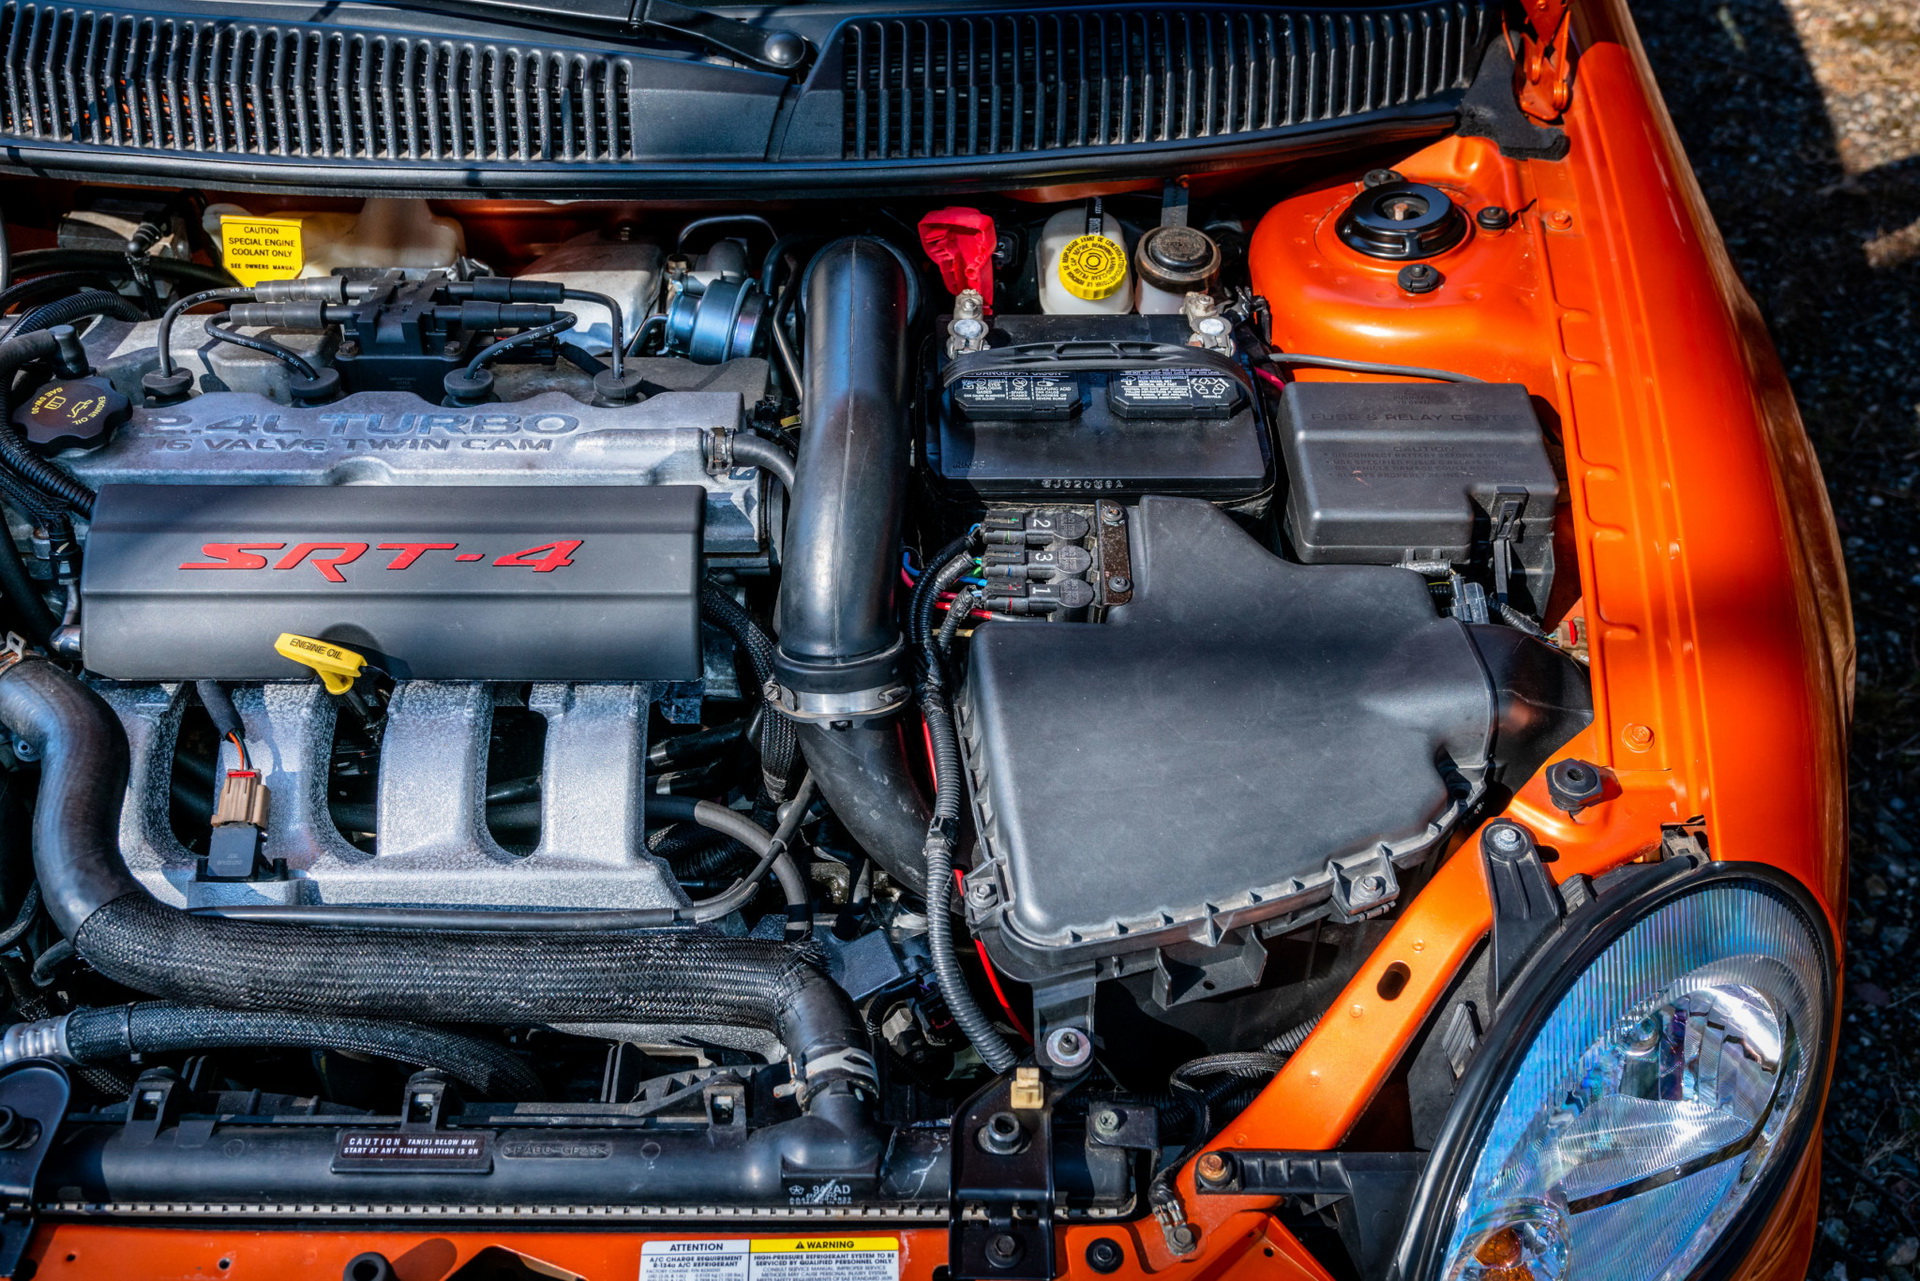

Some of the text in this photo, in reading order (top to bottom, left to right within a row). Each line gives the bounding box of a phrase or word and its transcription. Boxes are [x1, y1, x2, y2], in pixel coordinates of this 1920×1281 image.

[244, 226, 279, 234] CAUTION
[228, 237, 296, 247] SPECIAL ENGINE
[231, 248, 270, 256] COOLANT
[44, 386, 64, 398] SAE
[71, 395, 107, 425] ENGINE OIL
[1311, 413, 1361, 421] FUSE
[1385, 413, 1443, 421] RELAY
[1451, 414, 1525, 422] CENTER
[145, 412, 580, 437] 2.4L TURBO
[155, 438, 553, 452] 16 VALVE TWIN CAM
[1033, 518, 1051, 528] 2
[178, 539, 585, 583] SRT-4
[1035, 553, 1053, 562] 3
[1032, 587, 1051, 595] 1
[289, 638, 344, 661] ENGINE OIL
[349, 1138, 400, 1146] CAUTION
[407, 1138, 432, 1146] FAN(S)
[399, 1147, 418, 1155] TIME
[420, 1147, 455, 1155] IGNITION
[670, 1243, 723, 1252] ATTENTION
[806, 1241, 855, 1249] WARNING
